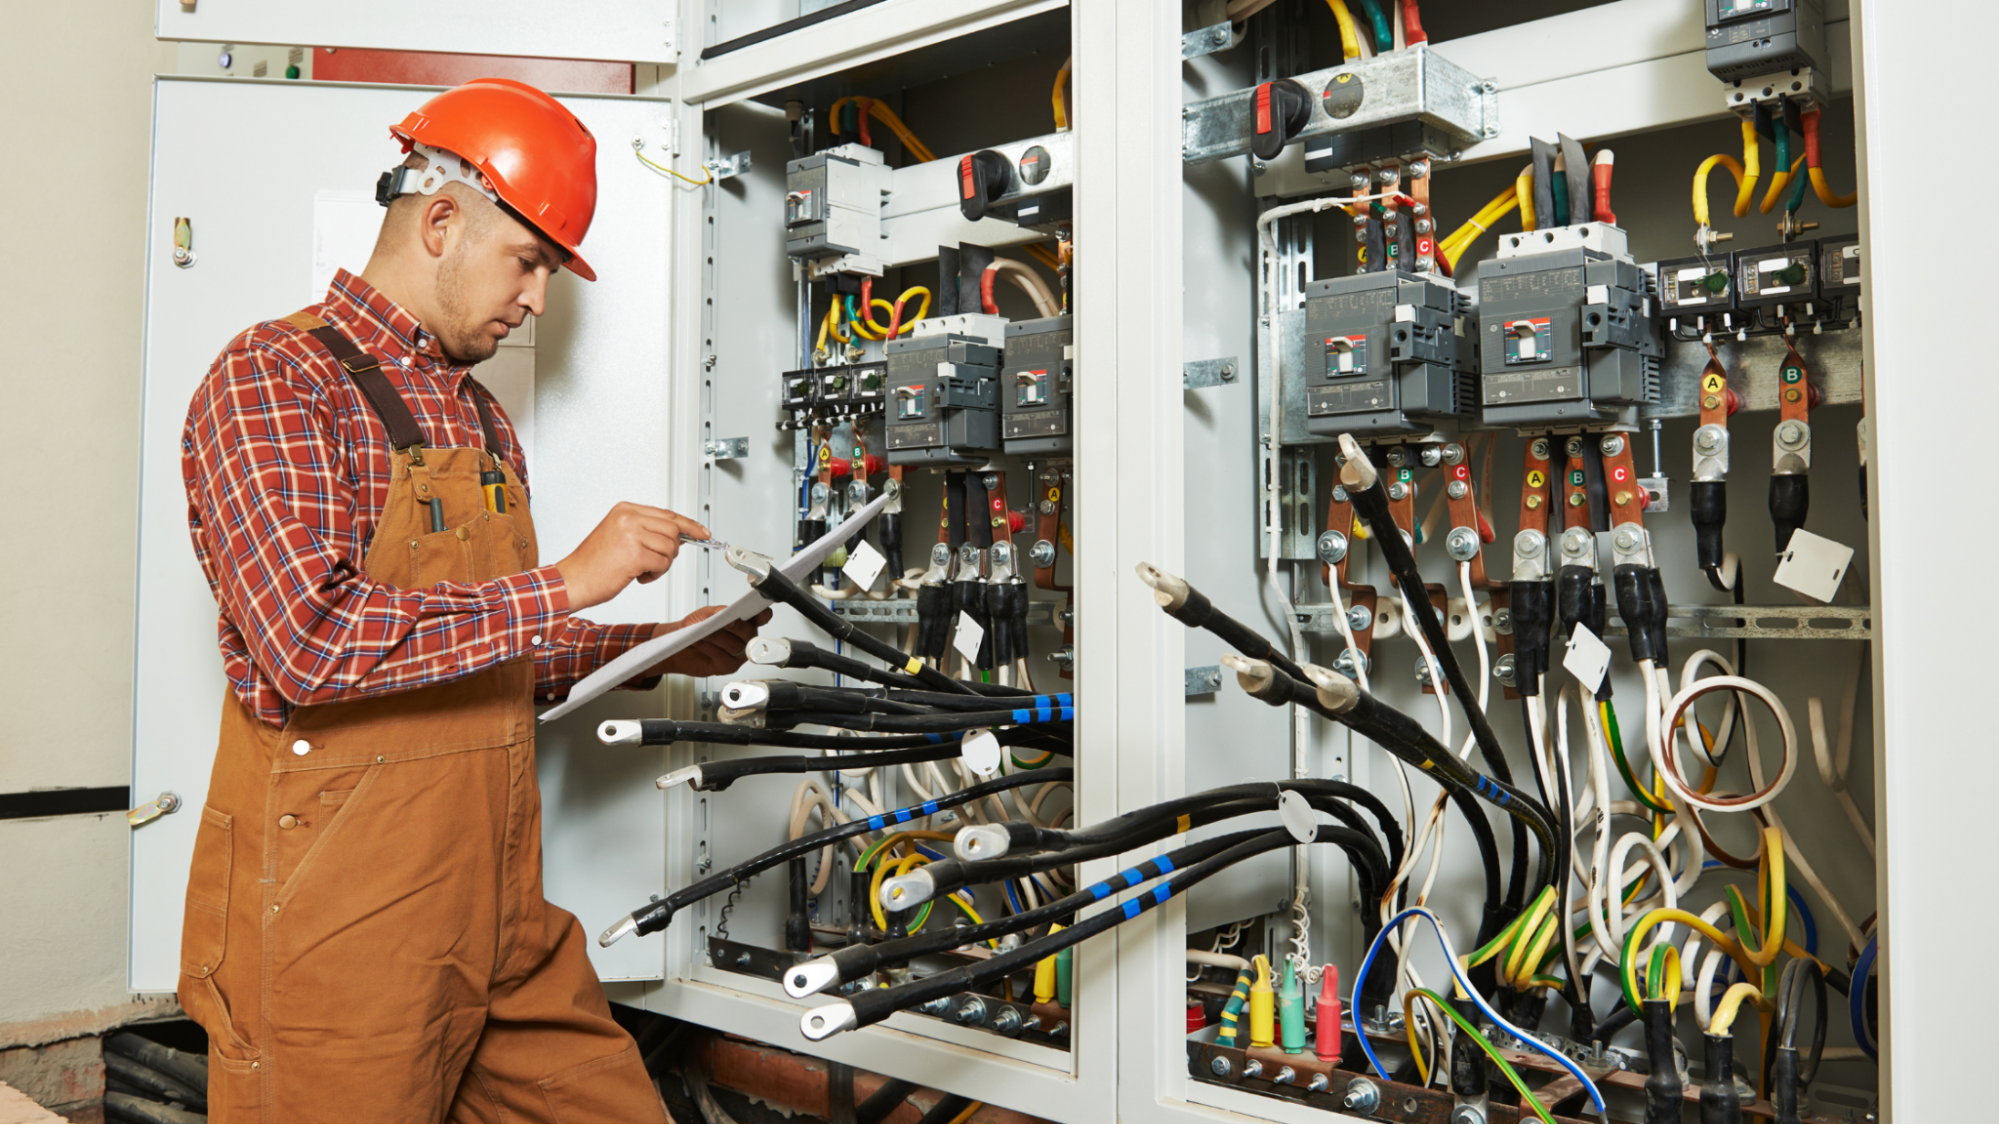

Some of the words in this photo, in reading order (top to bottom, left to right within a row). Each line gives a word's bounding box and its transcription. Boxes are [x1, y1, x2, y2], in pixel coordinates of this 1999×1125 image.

[1391, 244, 1398, 255] B
[1420, 241, 1429, 252] C
[1787, 369, 1798, 381] B
[1707, 377, 1718, 389] A
[855, 448, 861, 456] B
[1401, 469, 1410, 479] B
[1457, 467, 1466, 477] C
[1615, 469, 1625, 479] C
[1531, 473, 1541, 483] A
[1574, 473, 1583, 484] B
[1051, 490, 1058, 499] A
[994, 500, 1001, 508] C
